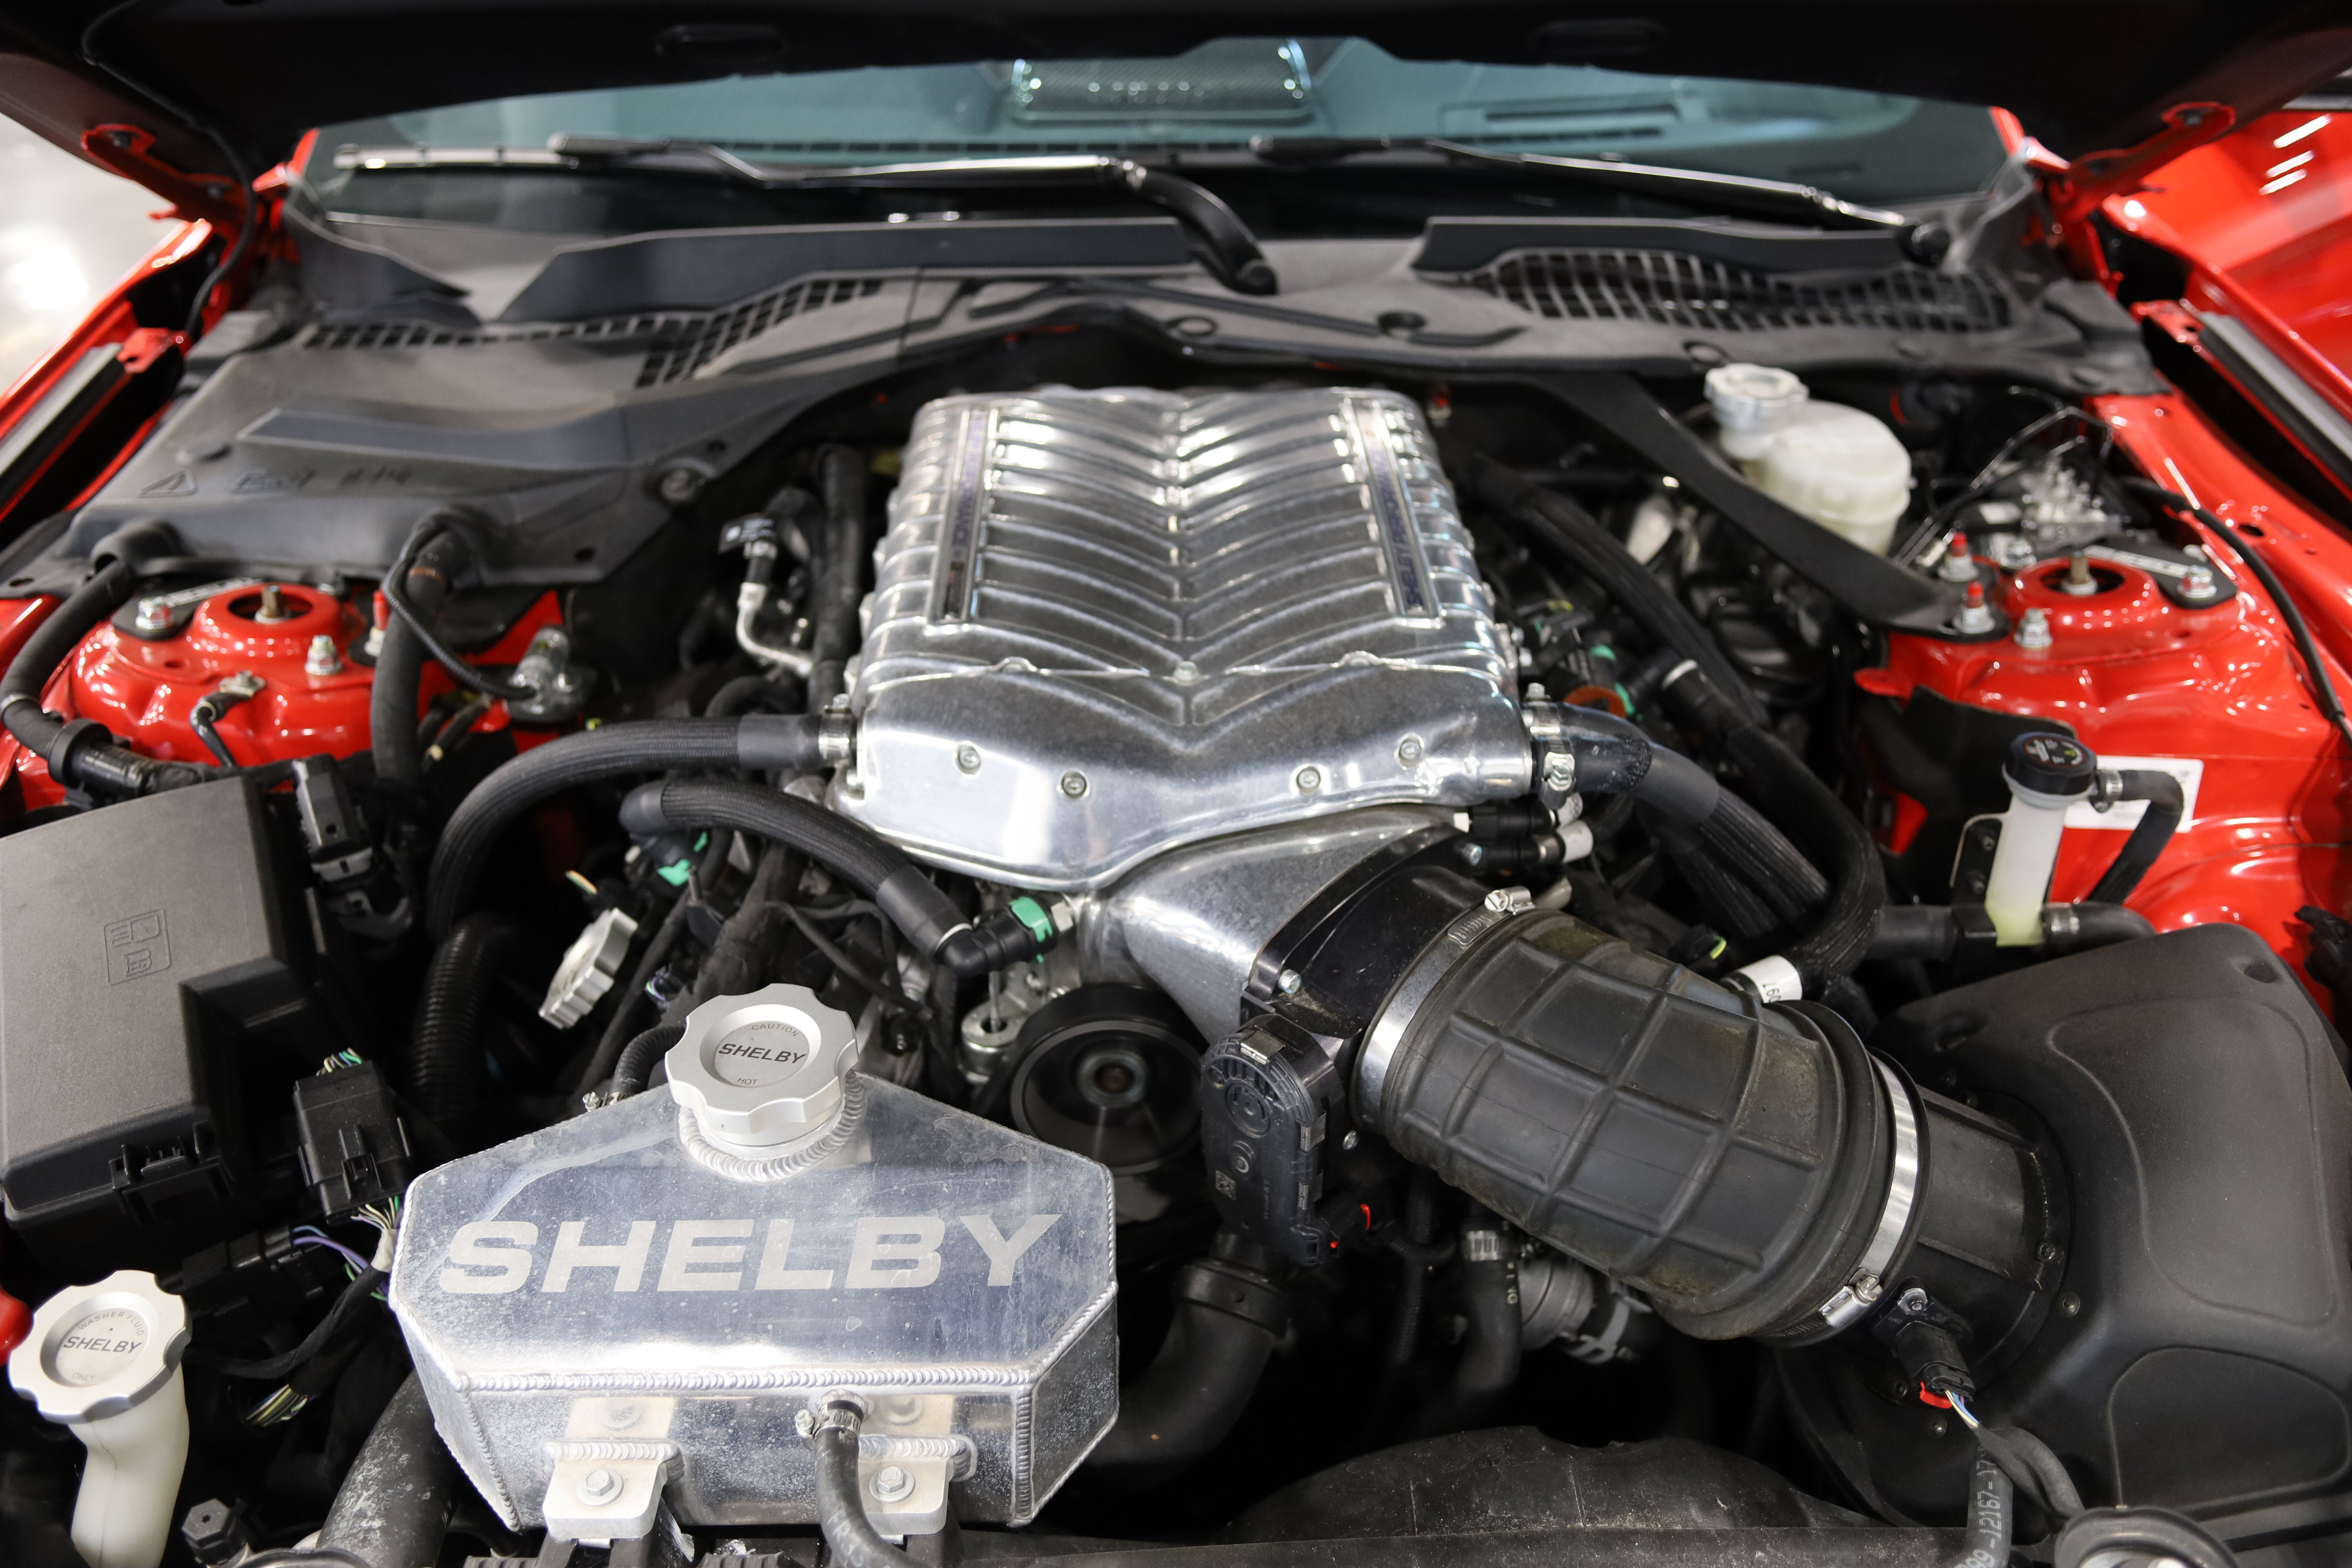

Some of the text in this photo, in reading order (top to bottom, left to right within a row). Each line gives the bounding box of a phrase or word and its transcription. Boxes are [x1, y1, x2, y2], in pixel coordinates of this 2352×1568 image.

[751, 1023, 800, 1037] CAUTION
[718, 1043, 807, 1064] SHELBY
[737, 1077, 759, 1086] HOT
[438, 1213, 1062, 1294] SHELBY
[78, 1311, 145, 1336] WASHER FLUID
[63, 1336, 143, 1354] SHELBY
[72, 1372, 96, 1381] ONLY
